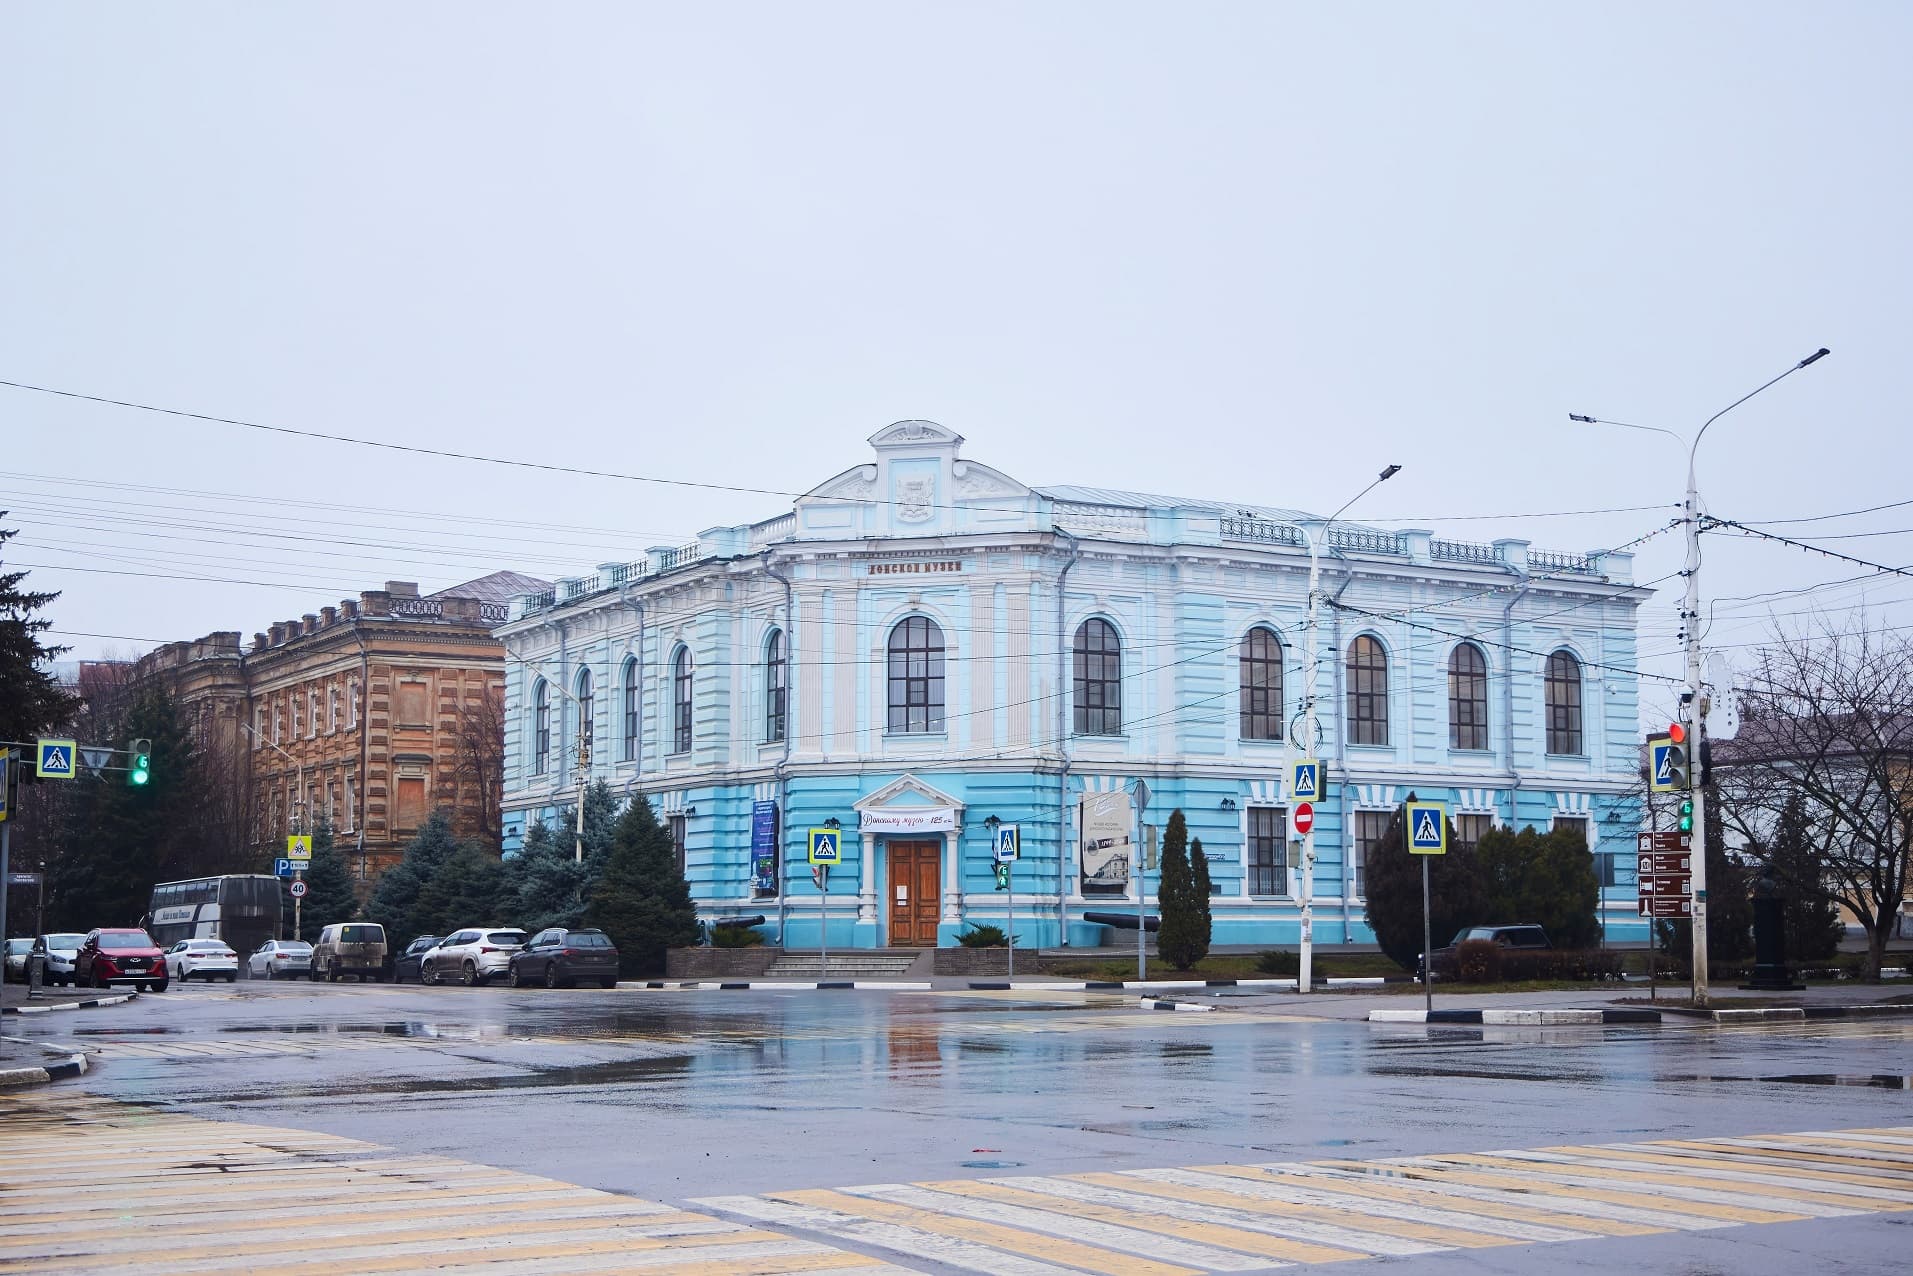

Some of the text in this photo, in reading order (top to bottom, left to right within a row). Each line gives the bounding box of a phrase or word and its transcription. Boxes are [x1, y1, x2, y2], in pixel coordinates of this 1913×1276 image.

[869, 561, 961, 575] ДОНСКОЙ МУЗЕЙ
[140, 756, 148, 768] 6
[863, 813, 900, 827] Донскому
[902, 817, 924, 827] музею
[930, 816, 943, 824] 125
[279, 860, 289, 875] P
[292, 884, 304, 893] 40
